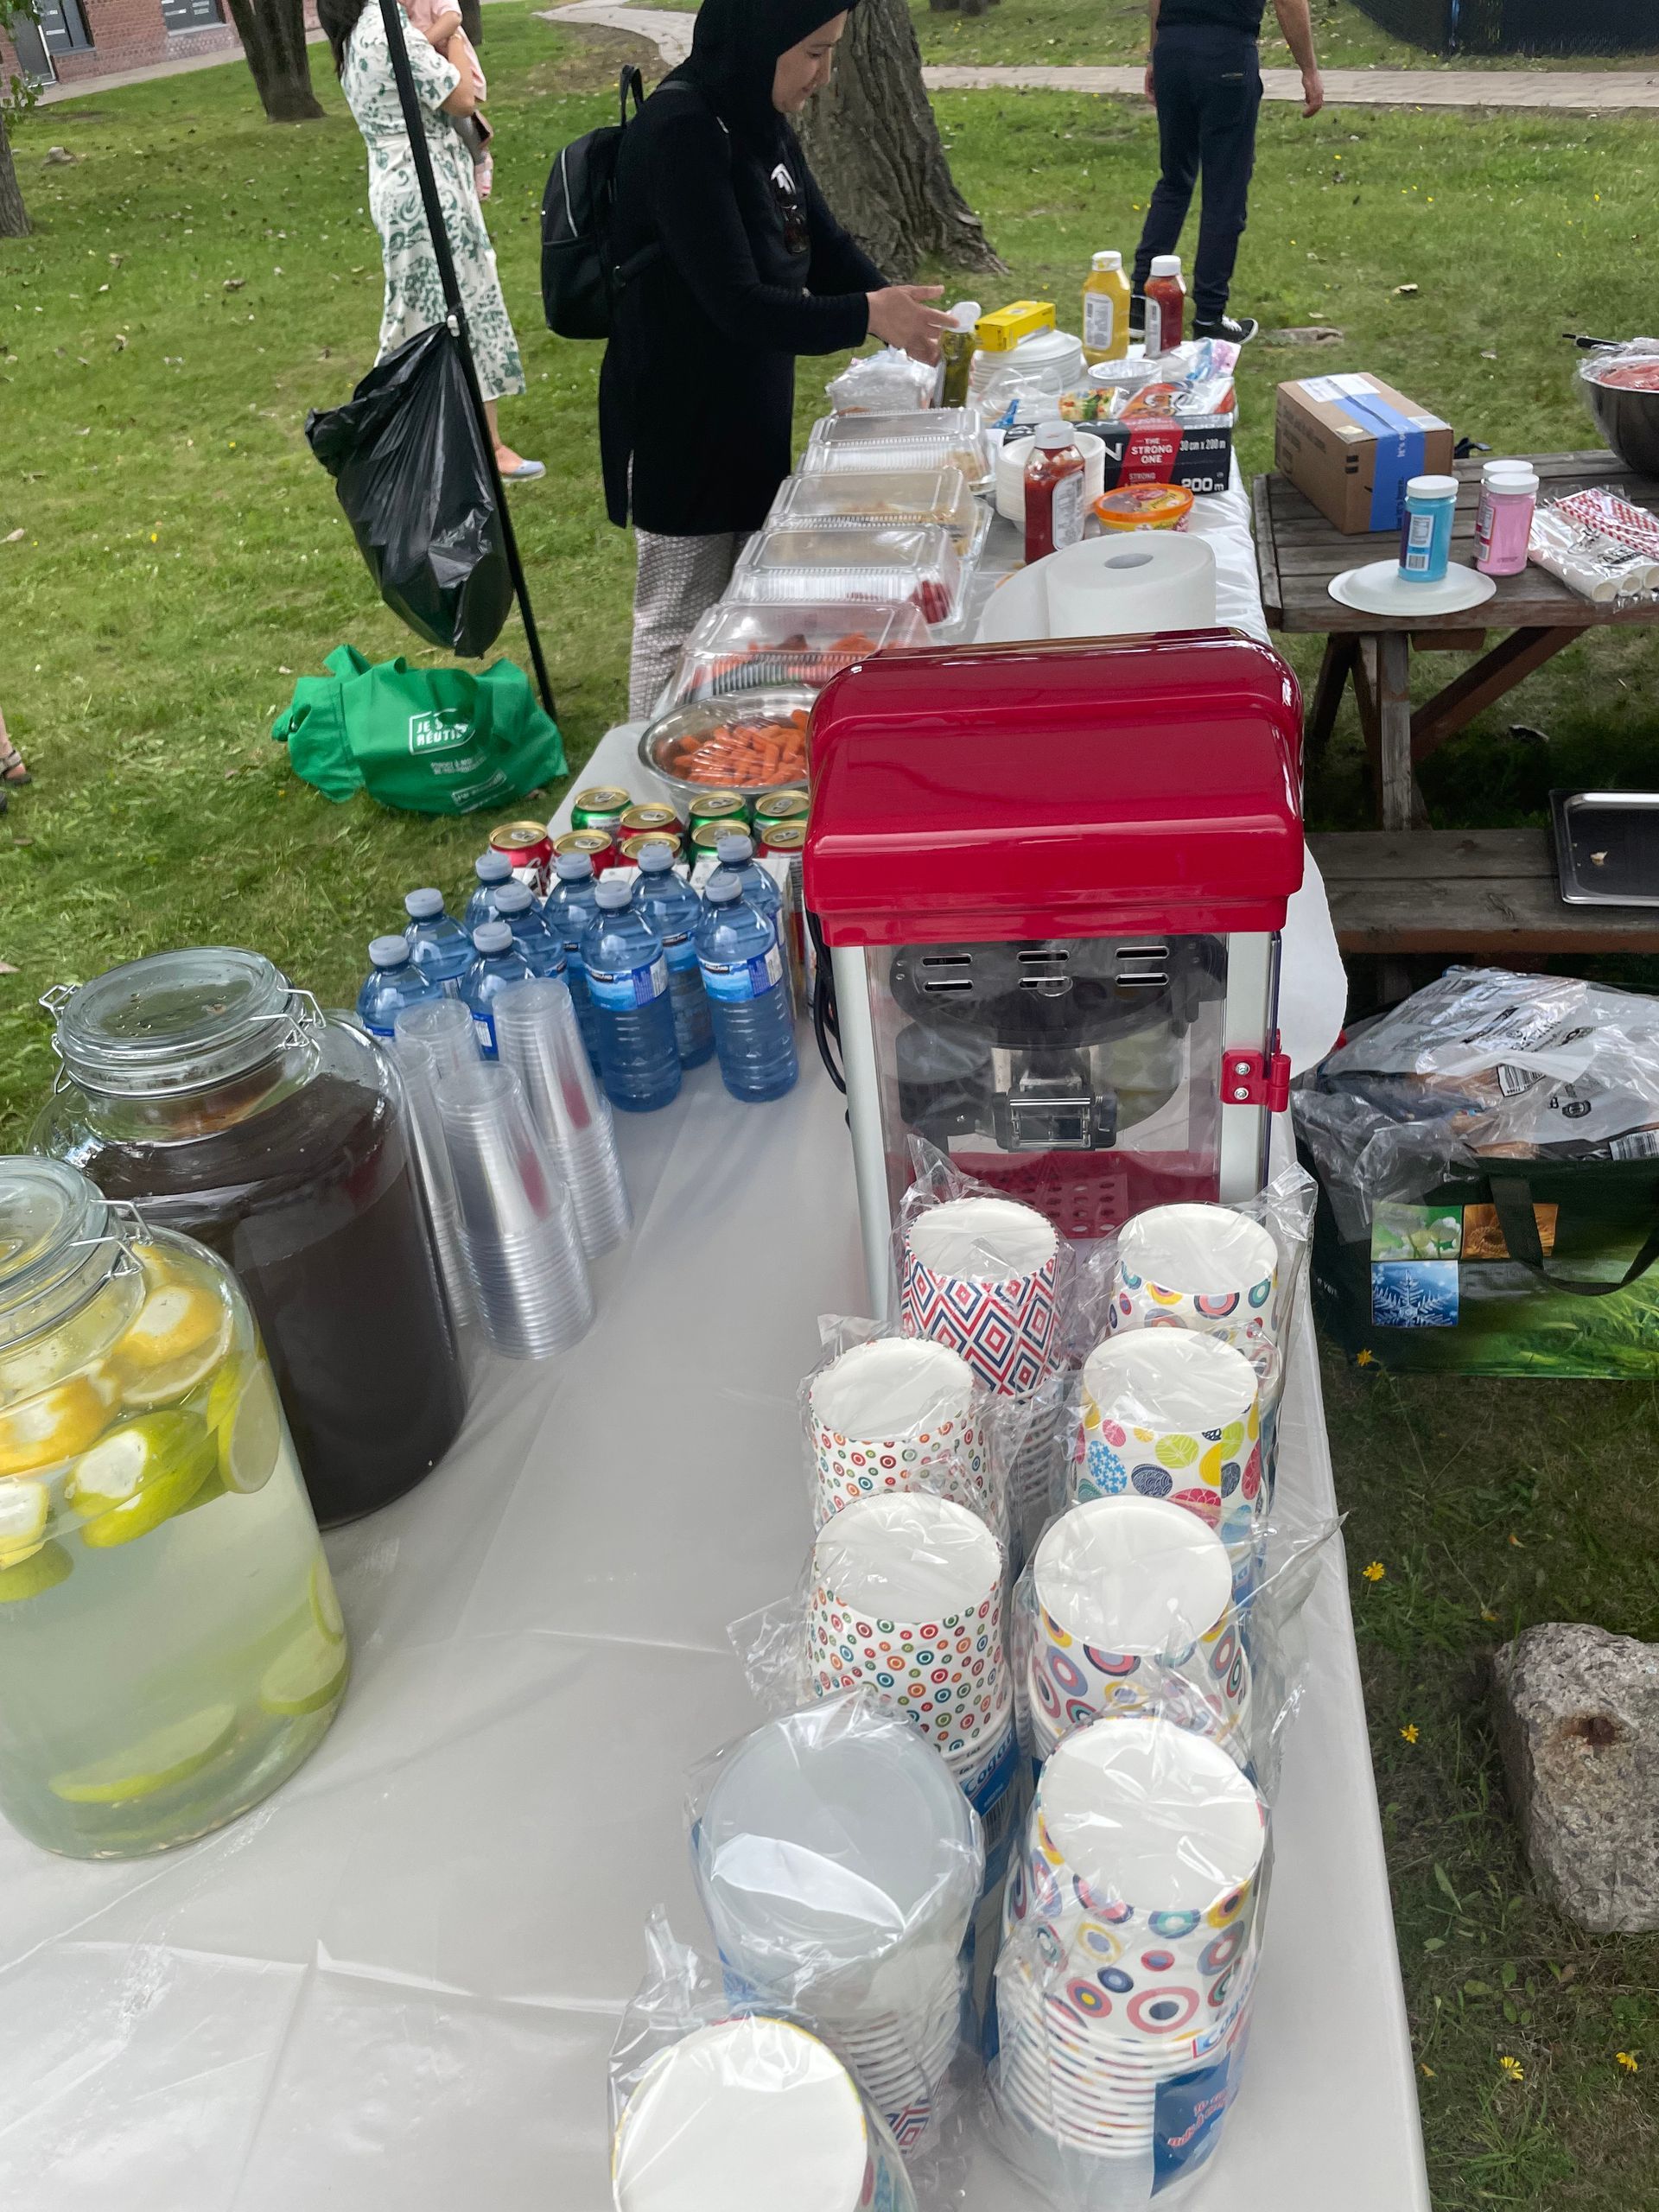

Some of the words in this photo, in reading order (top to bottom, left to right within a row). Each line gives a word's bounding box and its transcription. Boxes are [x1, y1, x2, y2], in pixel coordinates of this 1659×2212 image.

[1131, 444, 1173, 455] STRONG
[1141, 454, 1162, 464] ONE
[1181, 478, 1213, 493] 200
[1214, 482, 1224, 492] m
